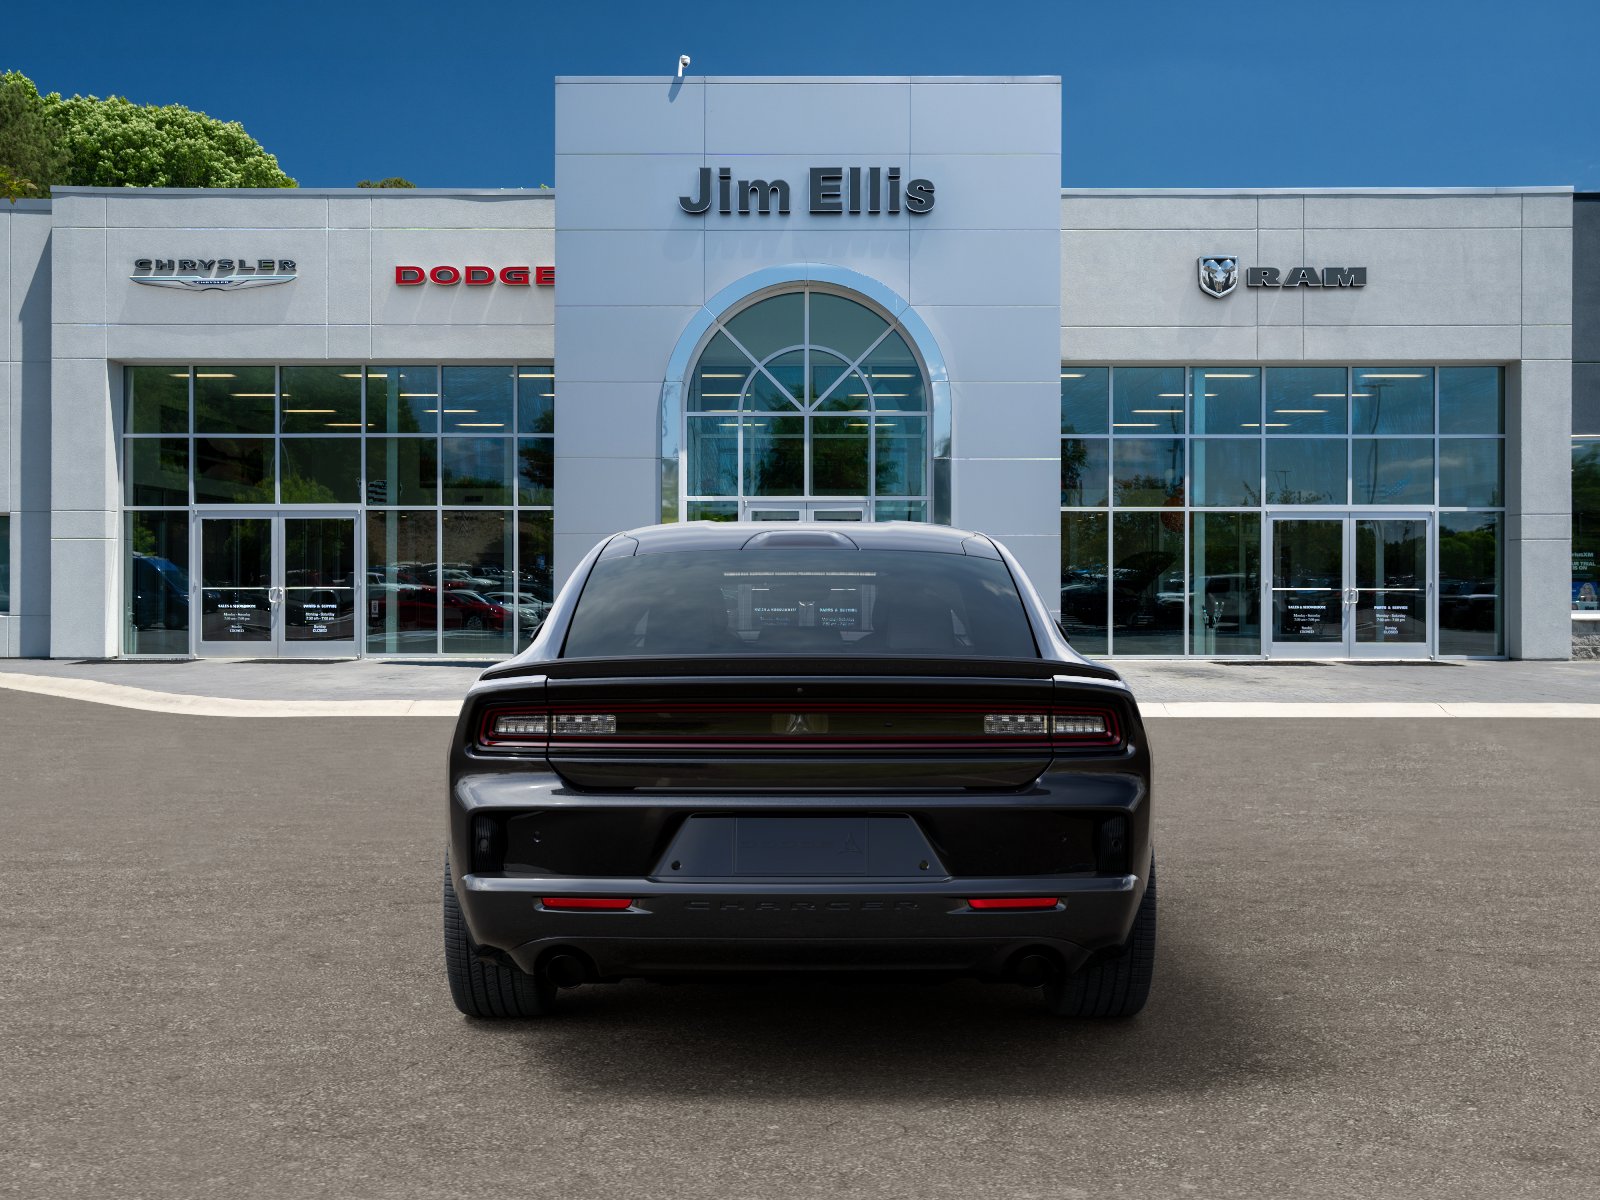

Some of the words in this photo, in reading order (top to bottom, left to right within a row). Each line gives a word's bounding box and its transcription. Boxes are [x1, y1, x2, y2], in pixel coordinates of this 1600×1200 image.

[679, 167, 790, 214] Jim
[809, 167, 935, 213] Ellis
[135, 259, 297, 271] CHRYSLER
[396, 266, 556, 286] DODGE
[1247, 267, 1367, 287] RAM
